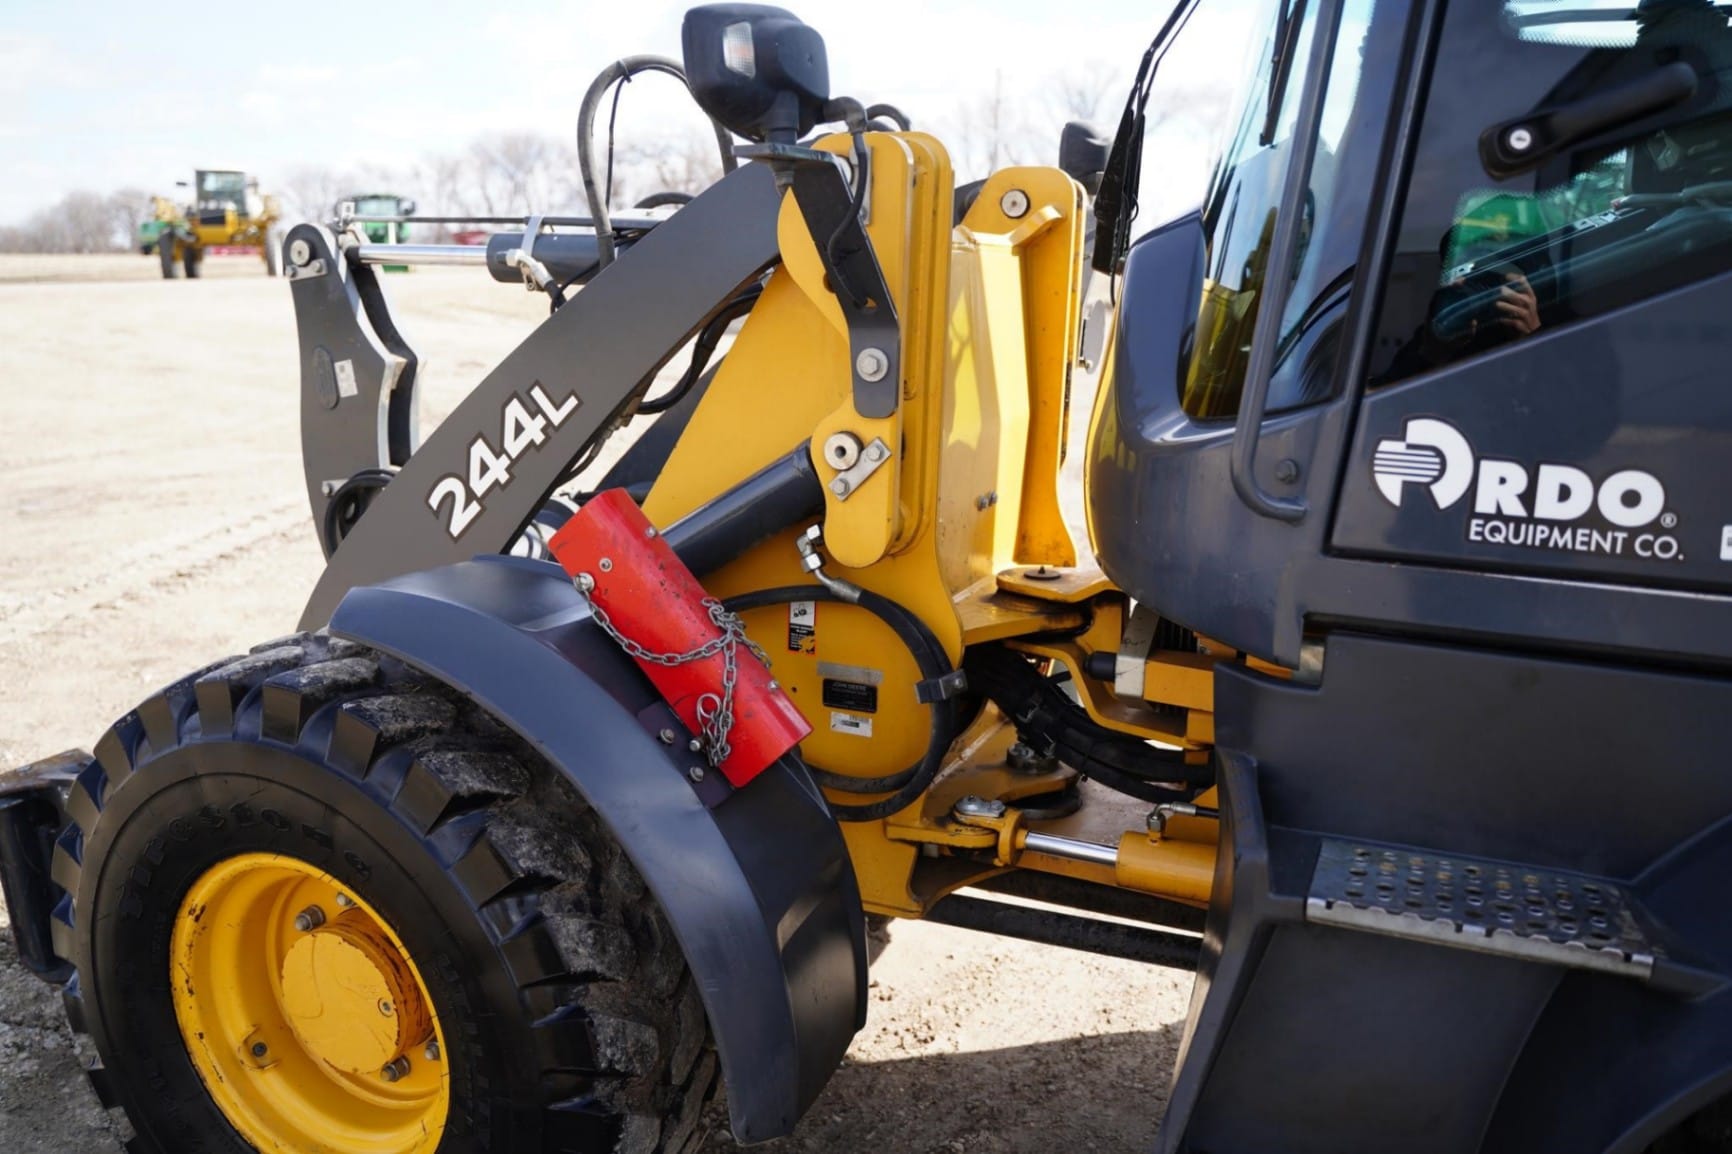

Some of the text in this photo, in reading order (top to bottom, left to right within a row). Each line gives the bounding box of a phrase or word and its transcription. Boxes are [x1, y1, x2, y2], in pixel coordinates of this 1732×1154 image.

[428, 384, 580, 539] 244L
[1469, 519, 1684, 560] EQUIPMENT CO.
